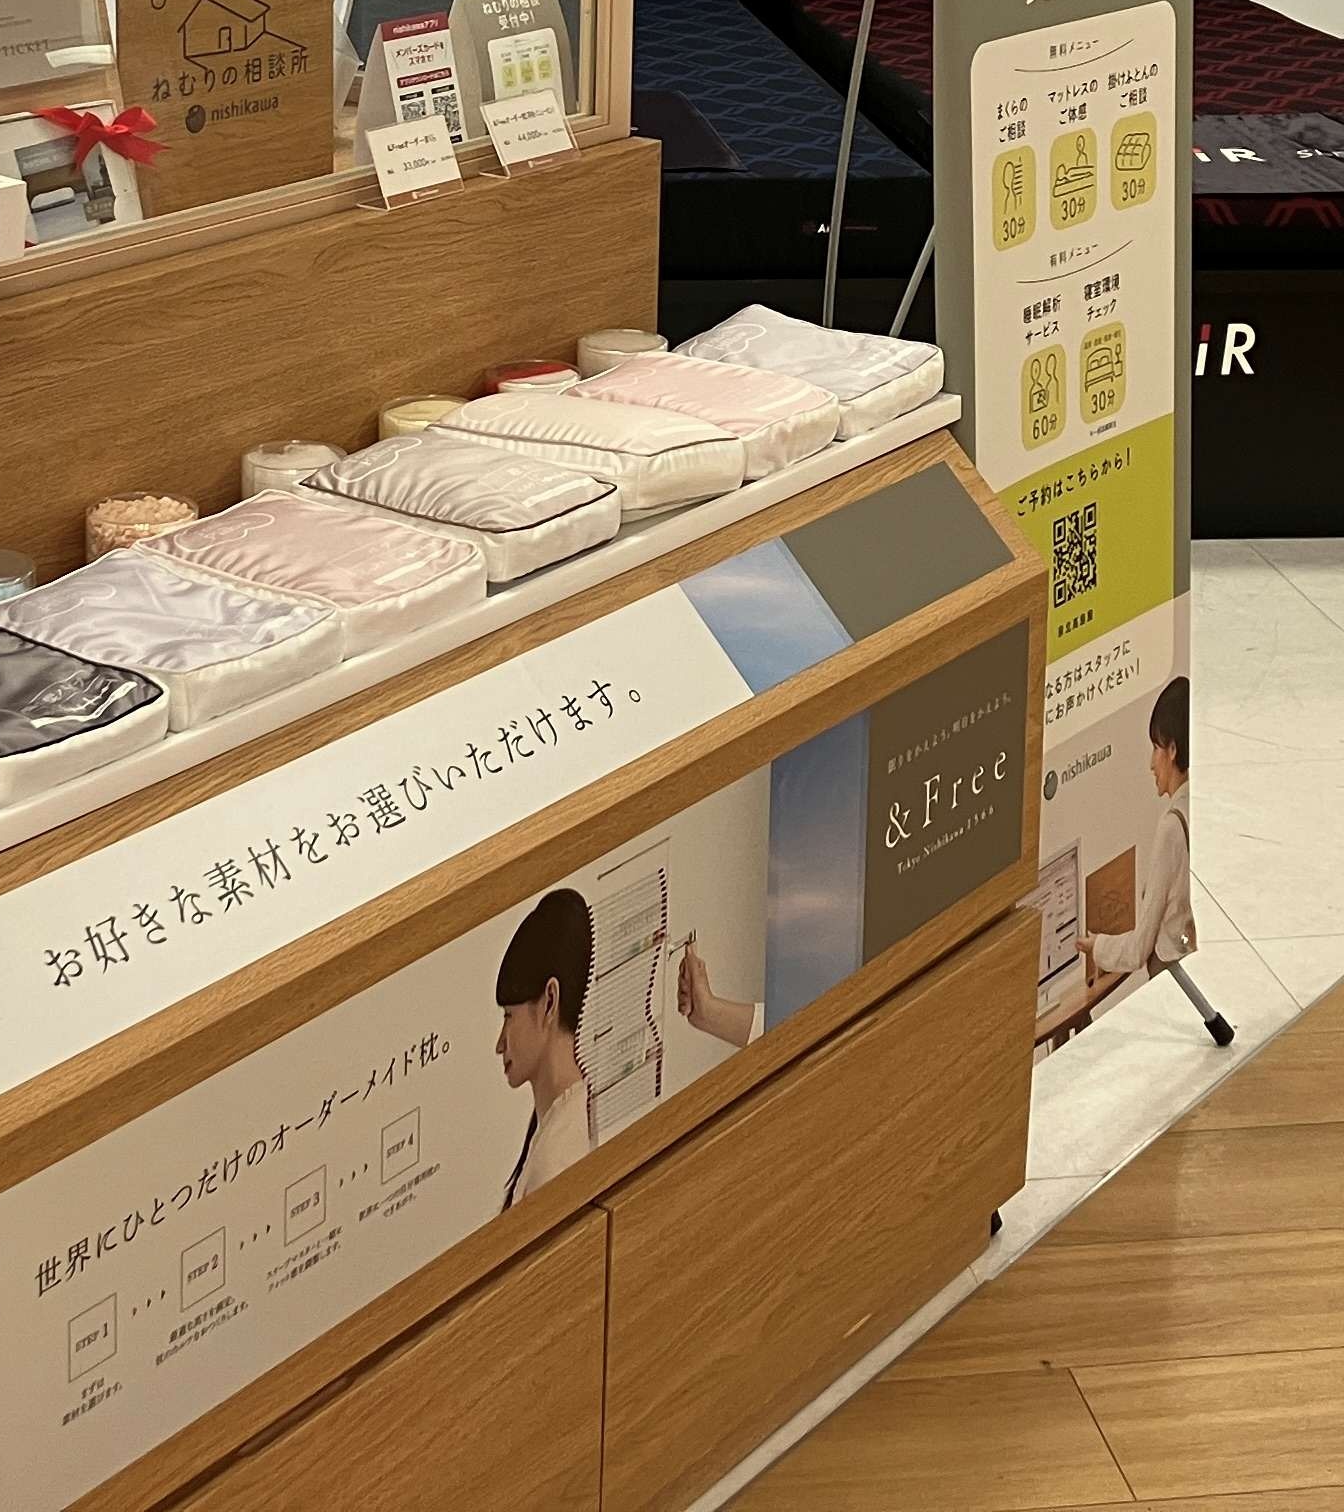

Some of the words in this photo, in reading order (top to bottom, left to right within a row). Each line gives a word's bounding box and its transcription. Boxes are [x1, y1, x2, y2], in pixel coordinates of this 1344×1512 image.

[1050, 39, 1099, 59] 無料メニュー
[152, 47, 310, 102] ねむりの相談所
[1108, 63, 1158, 90] 掛けふとんの
[1048, 79, 1098, 104] マットレスの
[1120, 87, 1148, 108] ご相談
[211, 95, 279, 122] nishikawa
[997, 97, 1028, 120] まくらの
[1059, 103, 1088, 125] ご体感
[999, 120, 1026, 142] ご相談
[1122, 178, 1146, 201] 30分
[1061, 199, 1085, 221] 30分
[1003, 216, 1026, 242] 30分
[1050, 243, 1098, 267] 有料メニュー
[1084, 273, 1120, 301] 寝室環境
[1023, 294, 1062, 324] 睡眠解析
[1086, 298, 1117, 322] チェック
[1025, 320, 1060, 345] サービス
[1194, 323, 1256, 376] iR
[1091, 389, 1115, 414] 30分
[1032, 414, 1058, 440] 60分
[1017, 447, 1132, 517] ご予約はこちらから!
[1061, 744, 1112, 785] nishikawa
[885, 802, 912, 848] &
[923, 752, 1007, 829] Free
[42, 678, 644, 987] お好きな素材をお選びいただけます。
[35, 1031, 451, 1297] 世界にひとつだけのオーダーメイド枕。
[312, 1191, 320, 1207] 3
[210, 1254, 219, 1272] 2
[102, 1322, 108, 1338] 1
